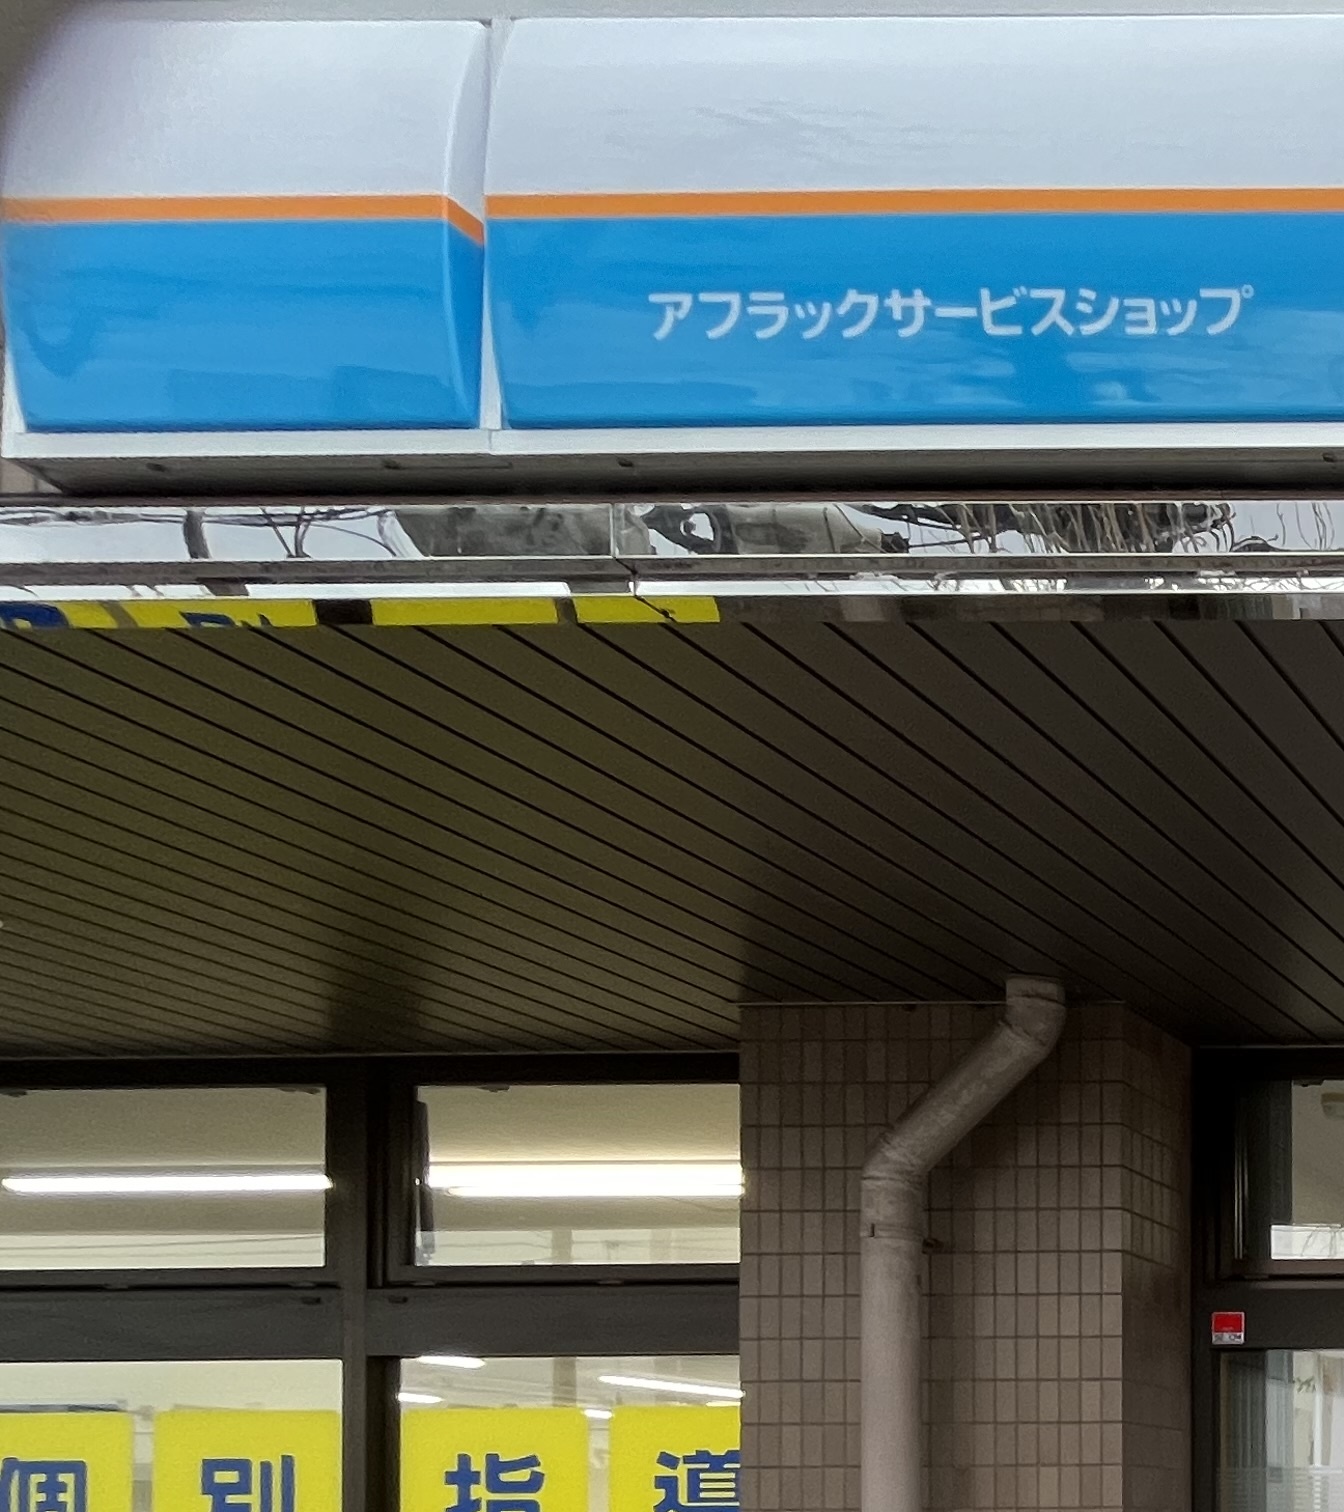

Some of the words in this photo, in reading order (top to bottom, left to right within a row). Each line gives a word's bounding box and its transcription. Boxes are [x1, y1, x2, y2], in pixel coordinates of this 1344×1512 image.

[648, 284, 1254, 341] アフラックサービスショップ
